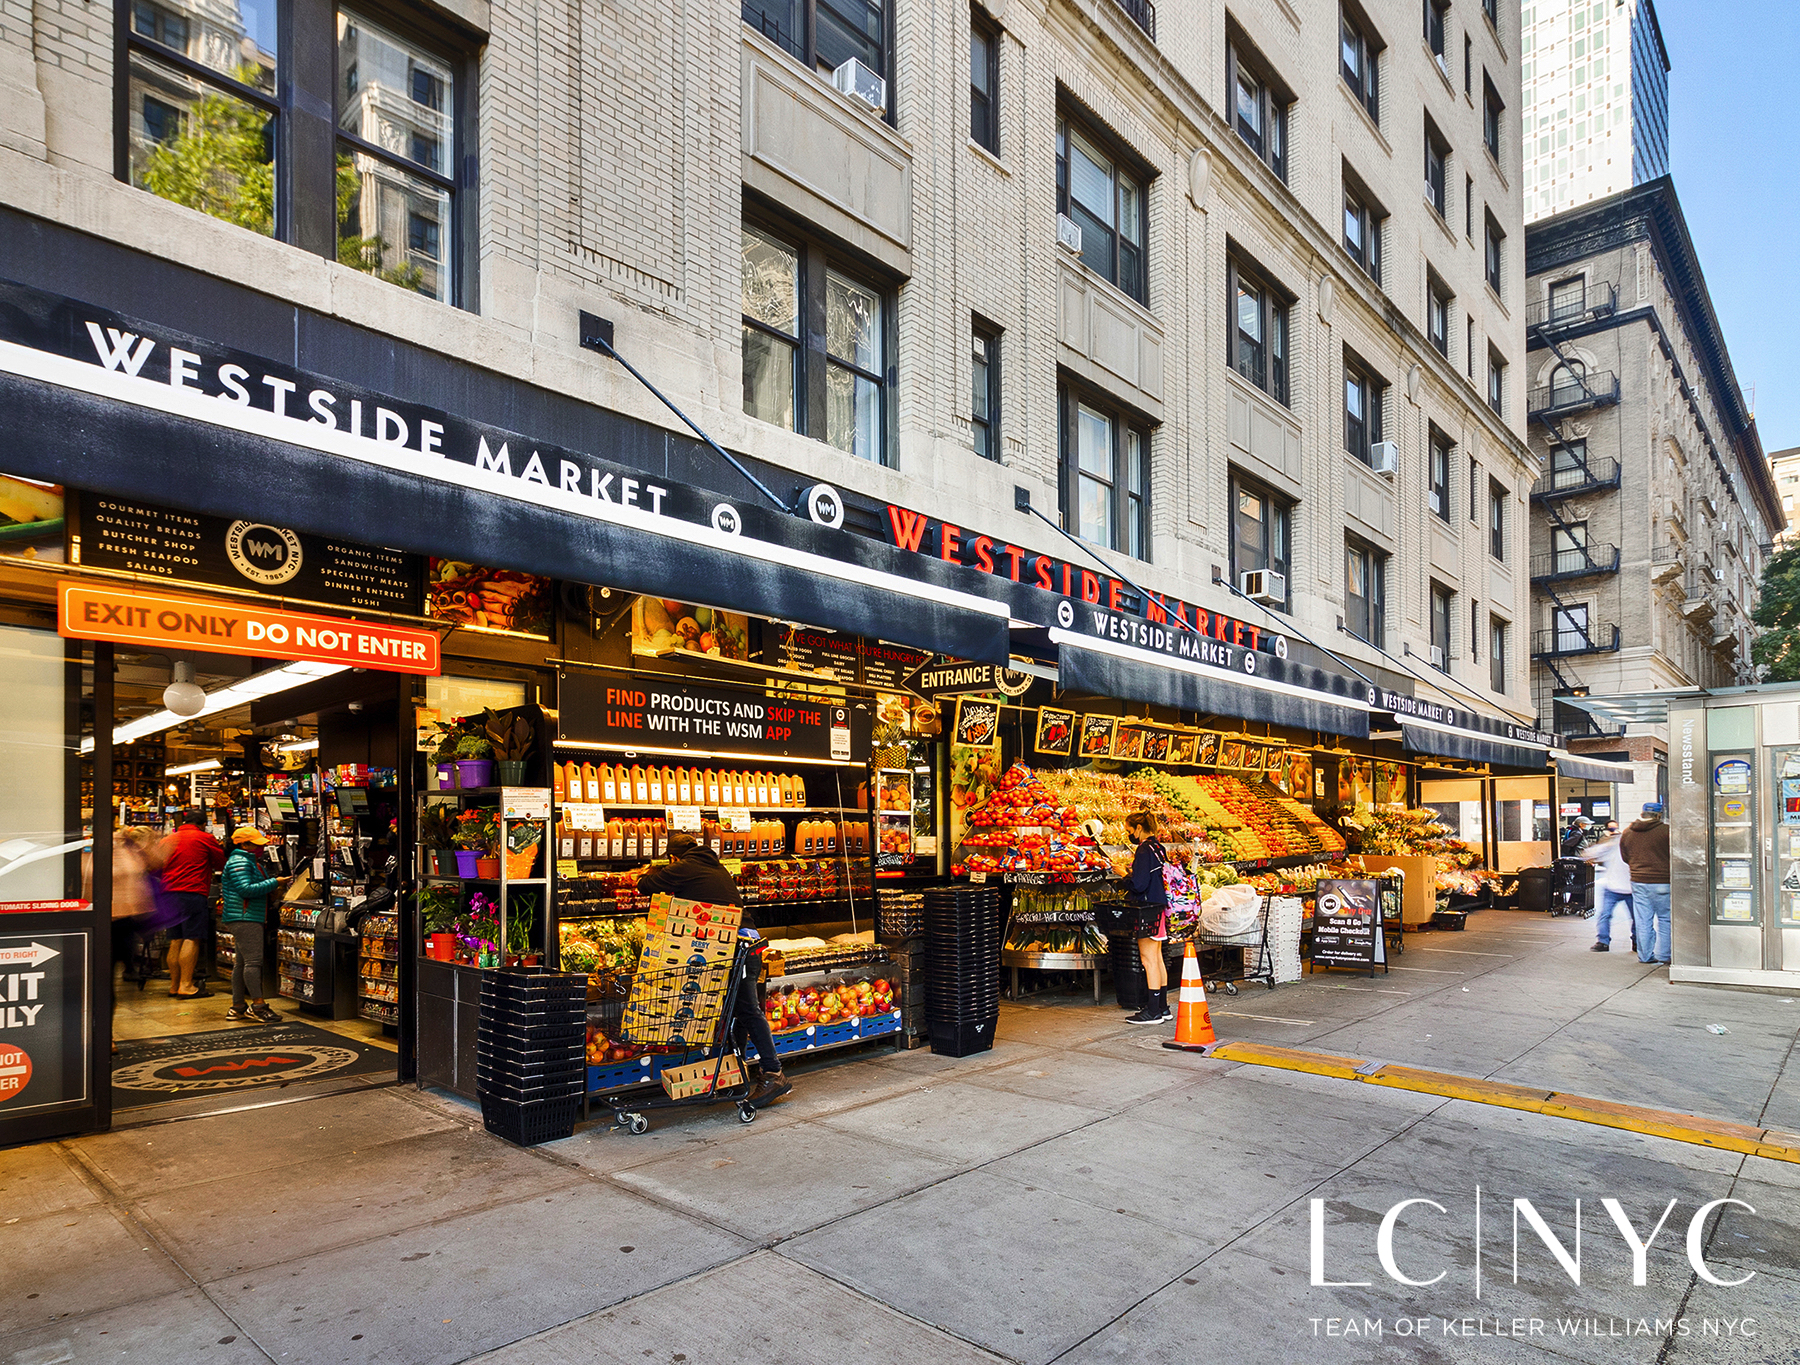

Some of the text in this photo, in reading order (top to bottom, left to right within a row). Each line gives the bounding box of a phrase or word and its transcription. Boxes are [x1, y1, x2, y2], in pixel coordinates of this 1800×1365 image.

[85, 321, 667, 515] WESTSIDE MARKET
[99, 501, 199, 526] GOURMET ITEMS
[817, 501, 835, 518] WM
[96, 514, 201, 540] QUALITY BREADS
[102, 529, 195, 551] BUTCHER SHOP
[229, 520, 252, 560] WESTSID
[287, 550, 300, 570] NYC
[247, 538, 283, 561] WM
[98, 542, 199, 565] FRESH SEAFOOD
[327, 545, 403, 564] ORGANIC ITEMS
[126, 561, 173, 575] SALADS
[321, 567, 409, 588] SPECIALITY MEATS
[334, 558, 396, 574] SANDWICHES
[325, 580, 405, 599] DINNER ENTREES
[887, 505, 1261, 651] WESTSIDE MARKET
[351, 597, 380, 607] SUSHI
[83, 601, 427, 662] EXIT ONLY DO NOT ENTER
[1093, 611, 1233, 667] WESTSIDE MARKET
[807, 635, 827, 647] GOT
[828, 639, 853, 652] WHAT
[883, 649, 915, 663] HUNGRY
[921, 666, 991, 689] ENTRANCE
[606, 688, 822, 726] FIND PRODUCTS AND SKIP THE
[1382, 692, 1443, 721] WESTSIDE MARKET
[606, 710, 792, 741] LINE WITH THE WSM APP
[1516, 728, 1536, 743] WESTSIDE
[1682, 718, 1696, 784] Newsstand
[0, 903, 31, 911] TOMATIC
[1343, 907, 1357, 916] Try
[1317, 926, 1370, 935] Mobile Checkout
[0, 951, 38, 960] TO RIGHT
